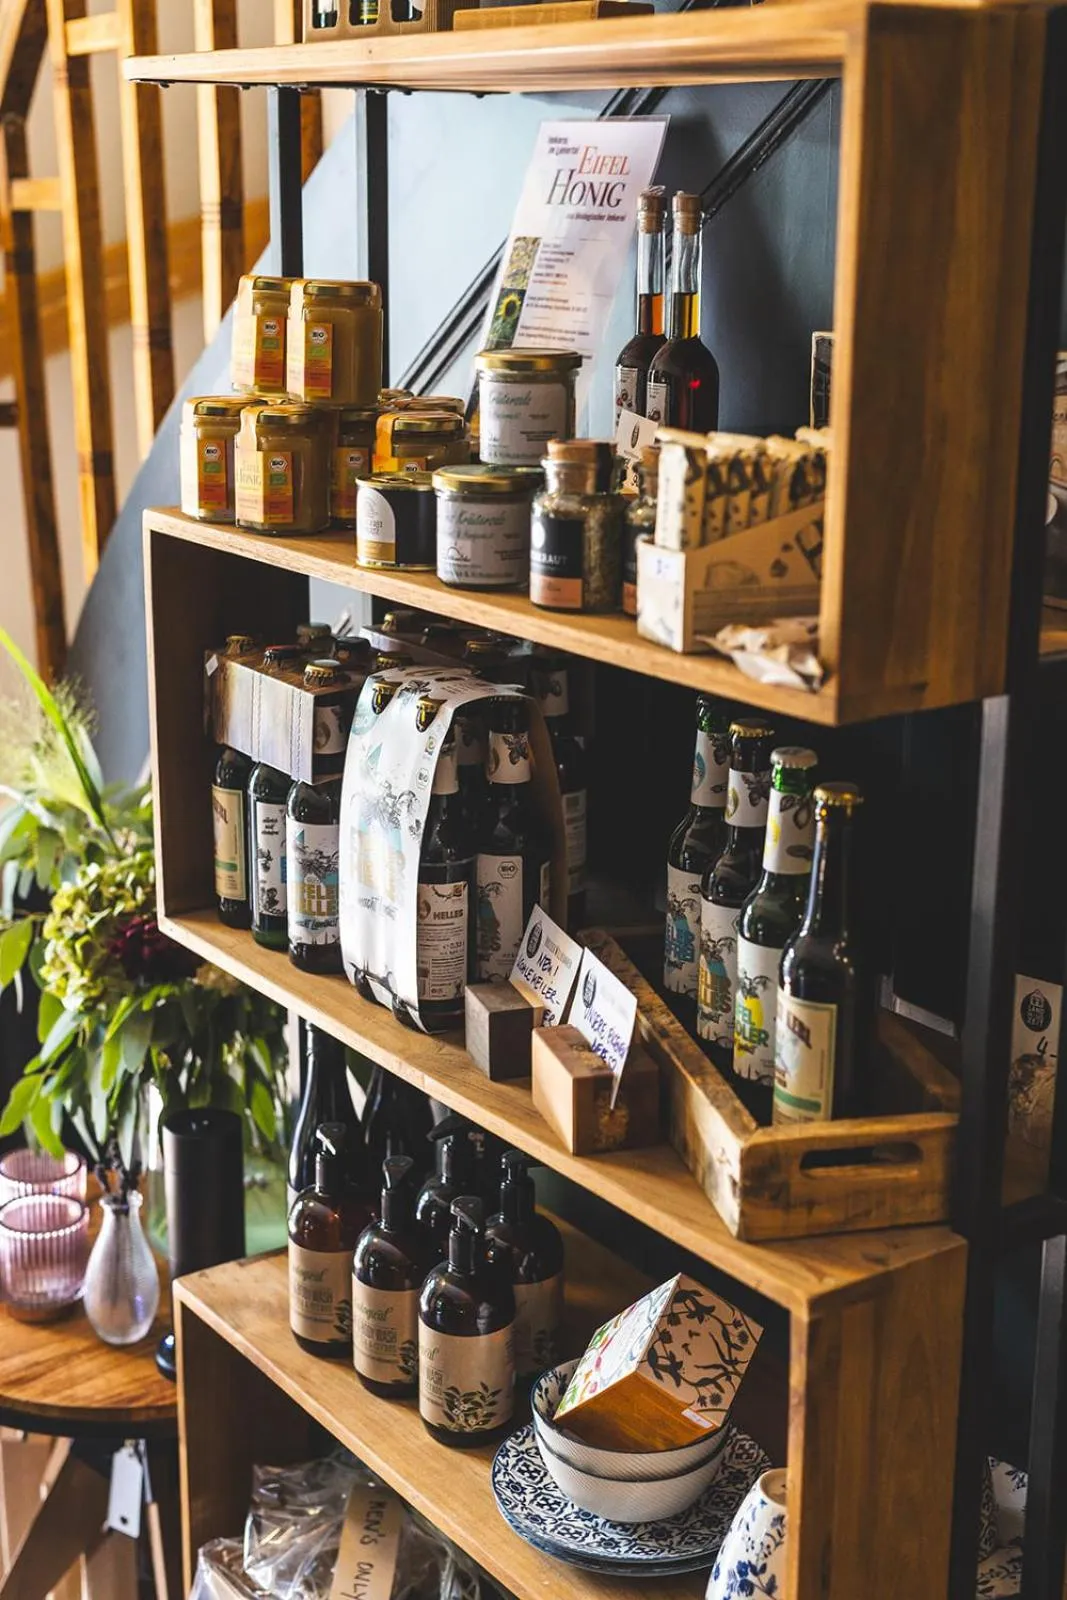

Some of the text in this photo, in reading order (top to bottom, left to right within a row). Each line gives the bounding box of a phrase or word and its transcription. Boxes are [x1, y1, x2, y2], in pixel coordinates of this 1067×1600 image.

[578, 145, 631, 176] EIFEL
[545, 168, 626, 208] HONIG
[433, 909, 464, 920] HELLES
[339, 1560, 375, 1600] ONLY
